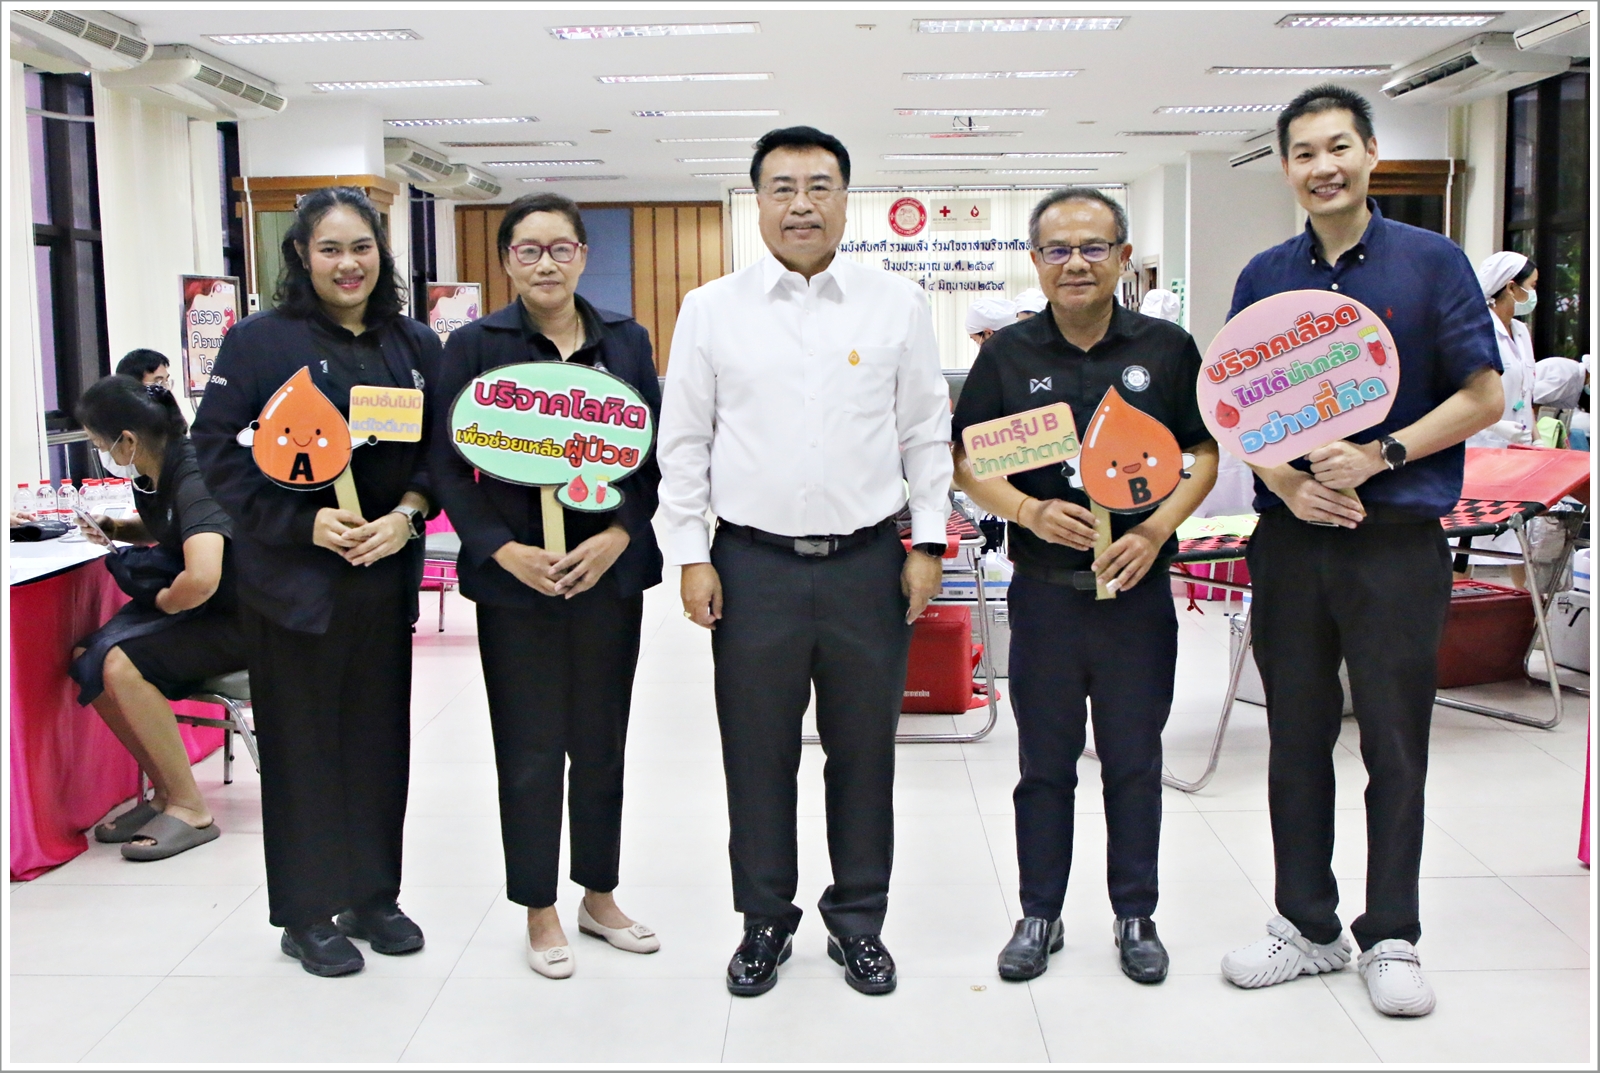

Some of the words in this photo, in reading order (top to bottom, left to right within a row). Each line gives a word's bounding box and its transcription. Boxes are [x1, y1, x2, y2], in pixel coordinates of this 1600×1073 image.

[189, 309, 222, 326] ตรวจ
[1204, 303, 1362, 384] บริจาคเลือด
[210, 375, 228, 387] 50th
[1232, 342, 1361, 409] ไม่ได้น่ากลัว
[473, 379, 647, 430] บริจาคโลหิต
[1238, 376, 1389, 455] อย่างที่คิด
[455, 422, 640, 469] เพื่อช่วยเหลือผู้ป่วย
[970, 415, 1040, 450] คนกรุ๊ป
[1041, 412, 1059, 432] B
[288, 452, 315, 482] A
[1127, 476, 1153, 506] B
